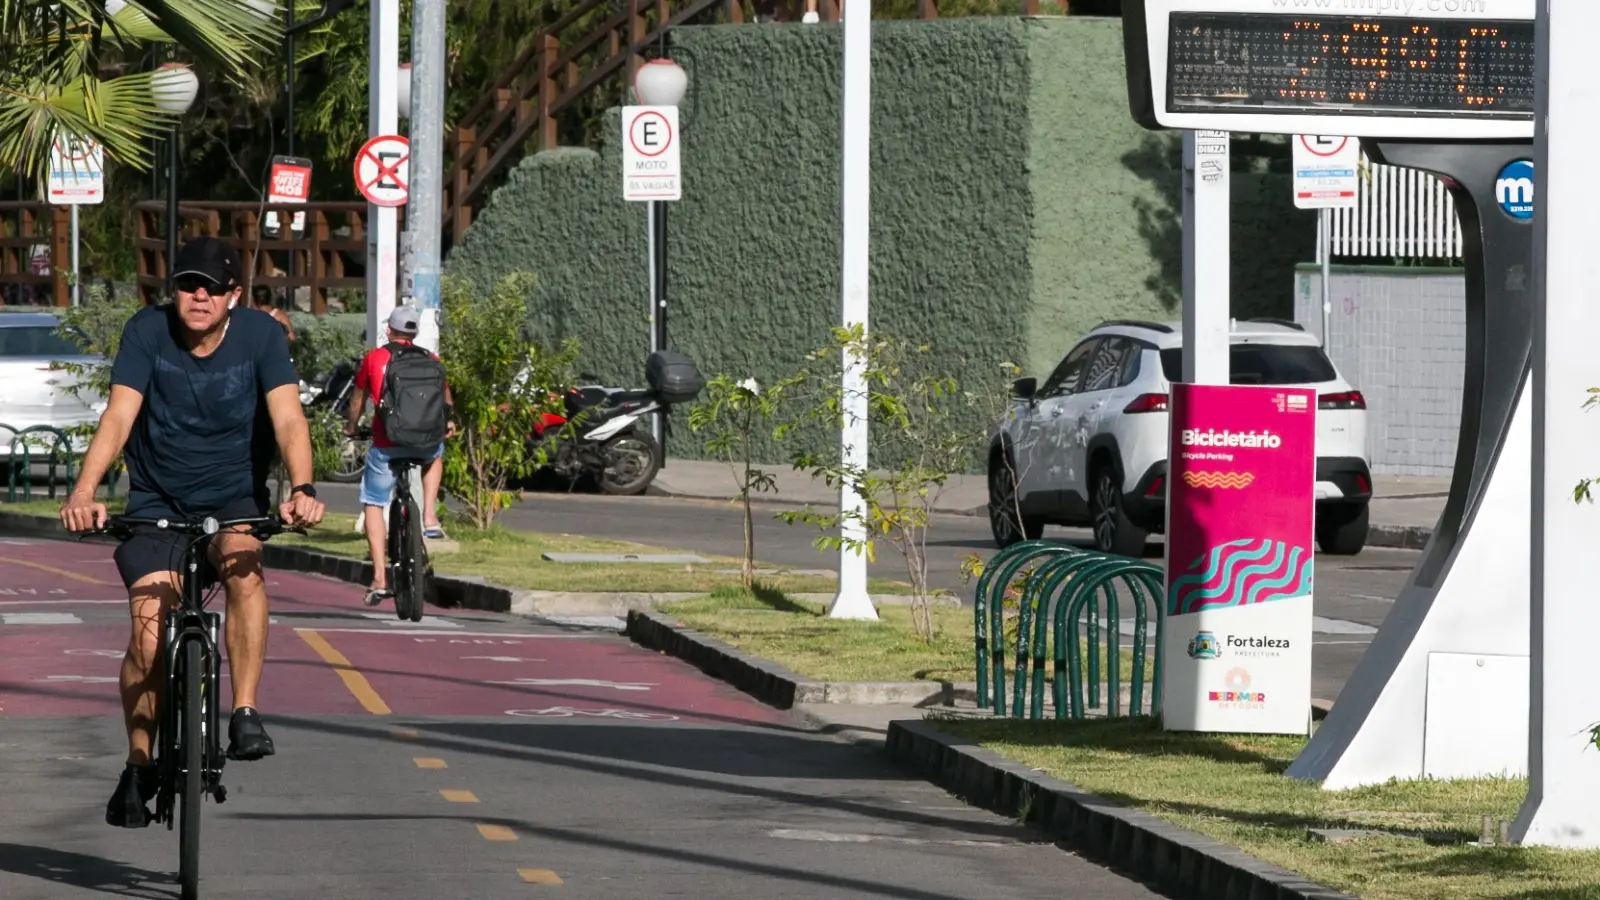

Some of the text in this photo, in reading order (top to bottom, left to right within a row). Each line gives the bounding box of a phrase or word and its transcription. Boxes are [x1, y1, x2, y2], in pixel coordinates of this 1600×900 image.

[643, 121, 658, 146] E
[635, 160, 668, 170] MOTO
[1182, 428, 1281, 448] Bicicletário
[1182, 452, 1233, 461] Bicycle Parking
[1227, 635, 1290, 648] Fortaleza
